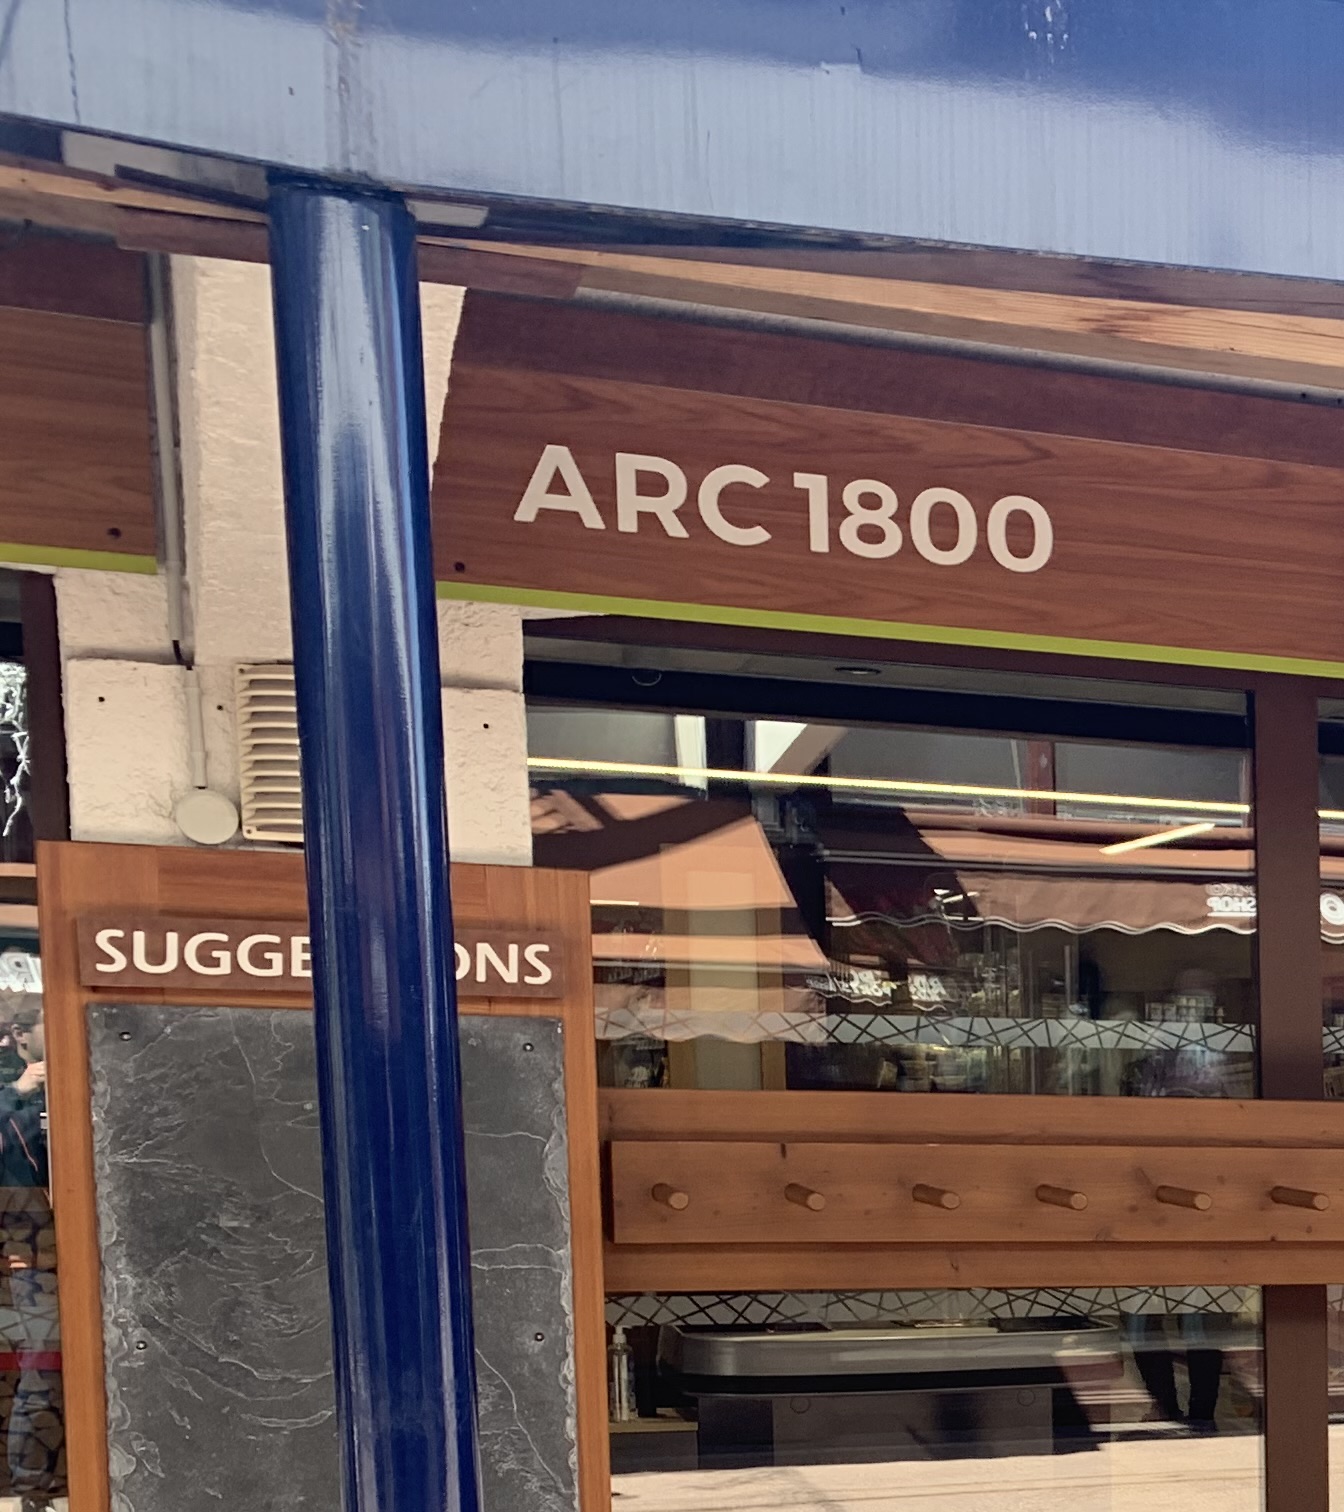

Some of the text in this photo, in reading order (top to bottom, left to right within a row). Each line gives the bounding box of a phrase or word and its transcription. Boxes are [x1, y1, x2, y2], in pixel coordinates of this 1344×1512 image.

[513, 444, 1054, 573] ARC 1800
[94, 928, 554, 985] SUGGENS
